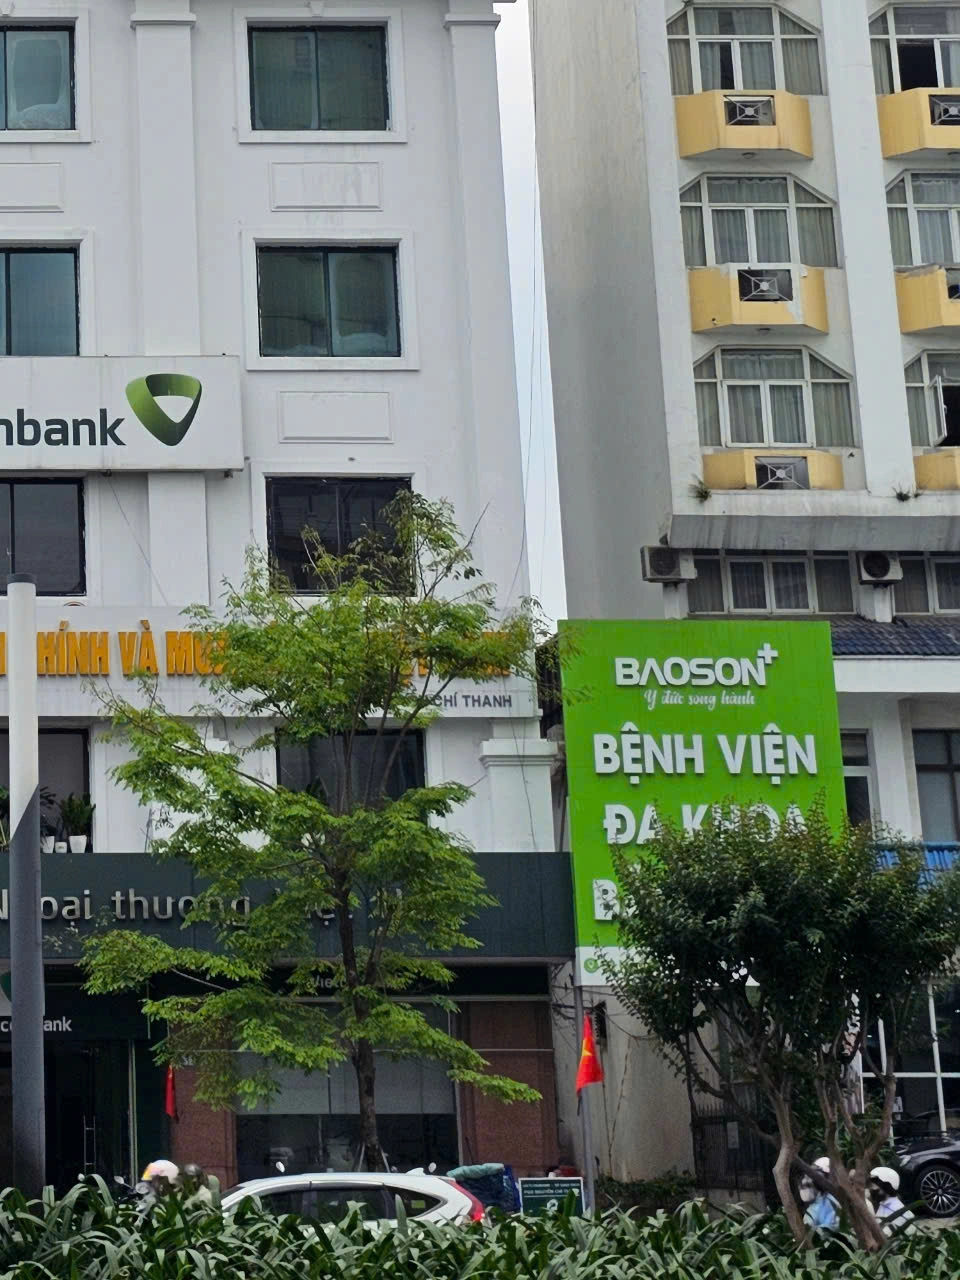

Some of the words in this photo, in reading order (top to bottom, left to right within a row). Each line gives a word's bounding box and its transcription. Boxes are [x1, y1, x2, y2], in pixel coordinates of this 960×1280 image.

[36, 620, 111, 677] HÍNH
[118, 619, 159, 677] VÀ
[614, 656, 767, 687] BAOSON
[462, 695, 513, 708] THANH
[688, 695, 717, 711] song
[721, 689, 756, 705] hành
[593, 721, 706, 785] BỆNH
[716, 722, 818, 785] VIỆN
[603, 804, 665, 845] ĐA
